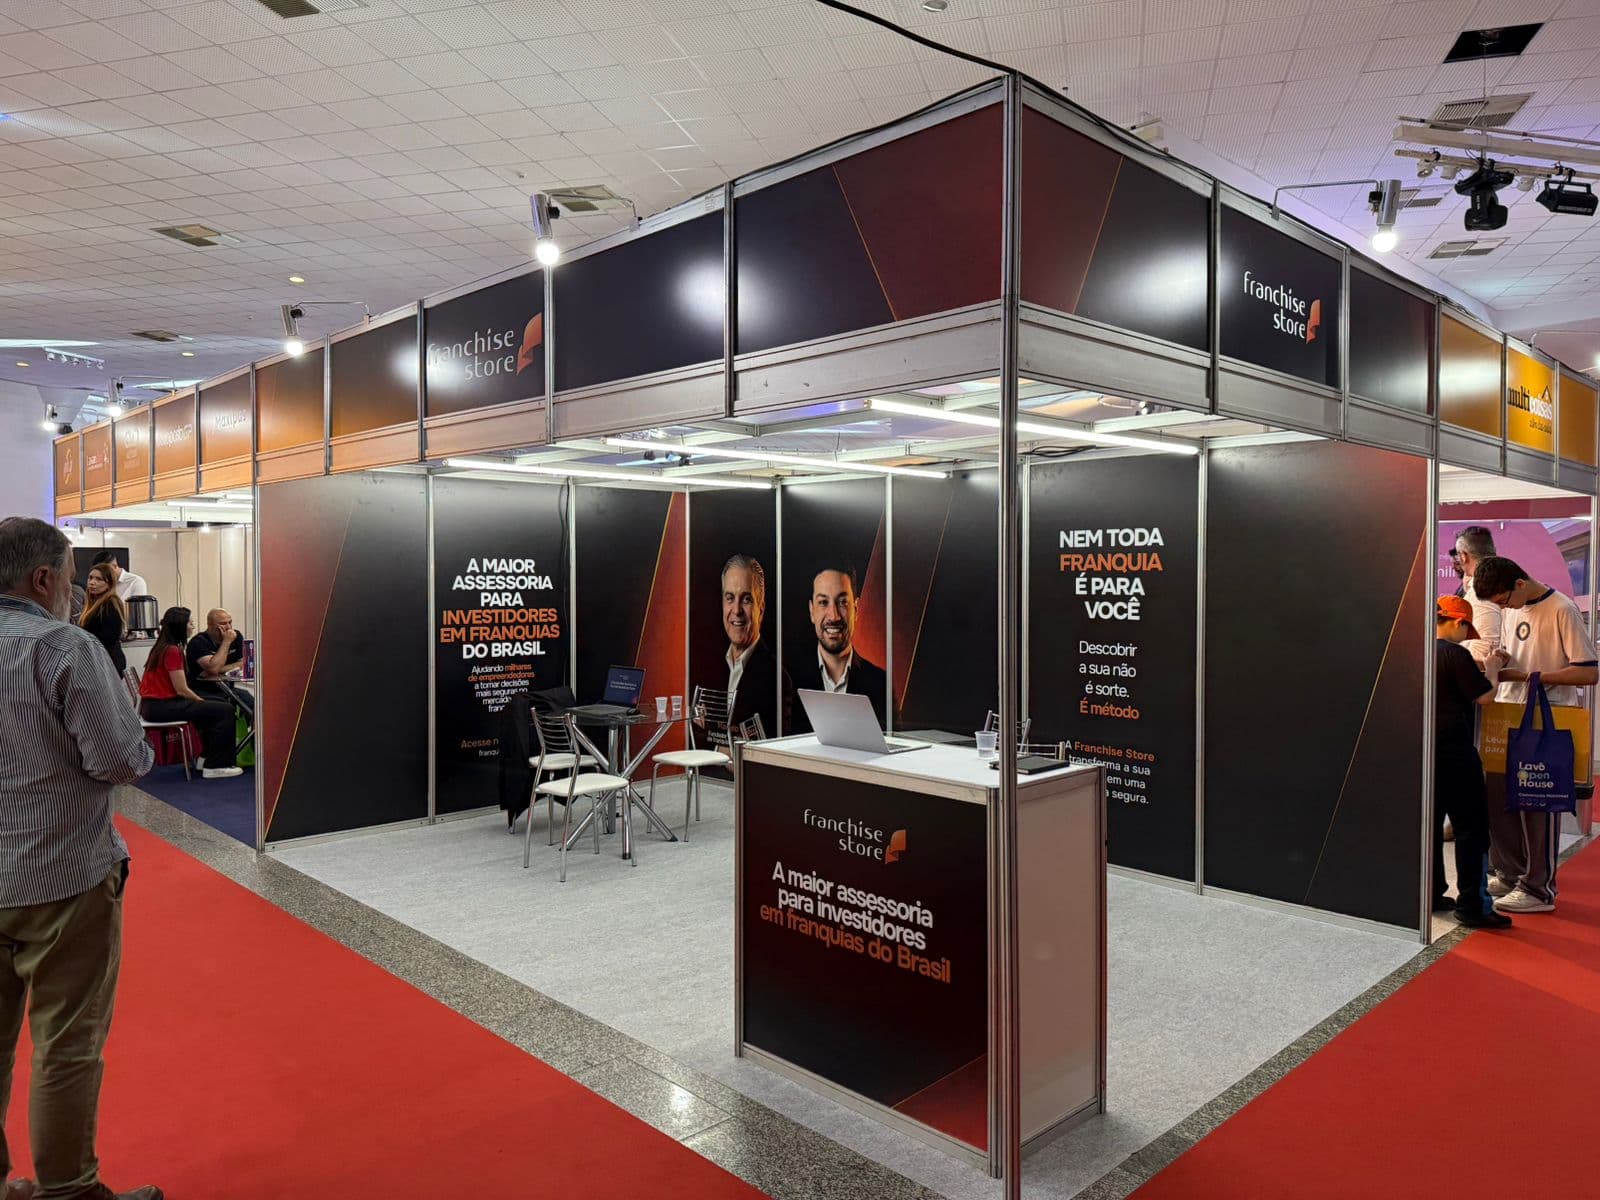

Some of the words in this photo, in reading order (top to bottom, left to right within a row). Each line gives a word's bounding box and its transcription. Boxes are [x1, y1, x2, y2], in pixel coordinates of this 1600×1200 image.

[1243, 270, 1307, 316] franchise
[1273, 310, 1307, 340] store
[427, 328, 515, 367] franchise
[464, 355, 515, 380] store
[1059, 529, 1103, 548] NEM
[1107, 527, 1164, 547] TODA
[466, 558, 480, 573] A
[483, 558, 535, 574] MAIOR
[1060, 553, 1163, 573] FRANQUIA
[452, 575, 553, 590] ASSESSORIA
[1075, 574, 1087, 595] É
[1091, 578, 1145, 596] PARA
[480, 592, 524, 607] PARA
[1084, 597, 1140, 621] VOCÊ
[442, 608, 558, 625] INVESTIDORES
[440, 627, 466, 643] EM
[469, 624, 560, 642] FRANQUIAS
[462, 643, 488, 659] DO
[491, 641, 546, 657] BRASIL
[1079, 640, 1138, 657] Descobrir
[468, 674, 478, 682] de
[479, 671, 535, 681] empreendedores
[471, 665, 504, 675] Ajudando
[505, 663, 532, 672] milhares
[1079, 664, 1086, 674] a
[1088, 665, 1110, 675] sua
[1112, 664, 1137, 678] não
[475, 690, 492, 698] mais
[480, 681, 500, 690] tomar
[501, 679, 530, 688] decisões
[1085, 681, 1093, 694] é
[1095, 683, 1130, 698] sorte.
[1080, 698, 1088, 714] É
[1090, 701, 1140, 720] método
[1065, 740, 1073, 749] A
[1074, 741, 1123, 757] Franchise
[1125, 748, 1155, 762] Store
[1068, 754, 1121, 771] transforma
[1123, 764, 1130, 772] a
[1132, 765, 1151, 776] sua
[1106, 775, 1121, 785] em
[1124, 778, 1146, 789] uma
[1518, 779, 1554, 788] House
[1112, 790, 1149, 804] segura.
[803, 808, 884, 843] franchise
[838, 836, 884, 861] store
[772, 861, 786, 884] A
[788, 870, 834, 898] maior
[837, 883, 934, 929] assessoria
[778, 888, 814, 915] para
[817, 895, 927, 951] investidores
[760, 904, 784, 927] em
[786, 908, 865, 954] franquias
[868, 938, 893, 963] do
[897, 944, 951, 984] Brasil
